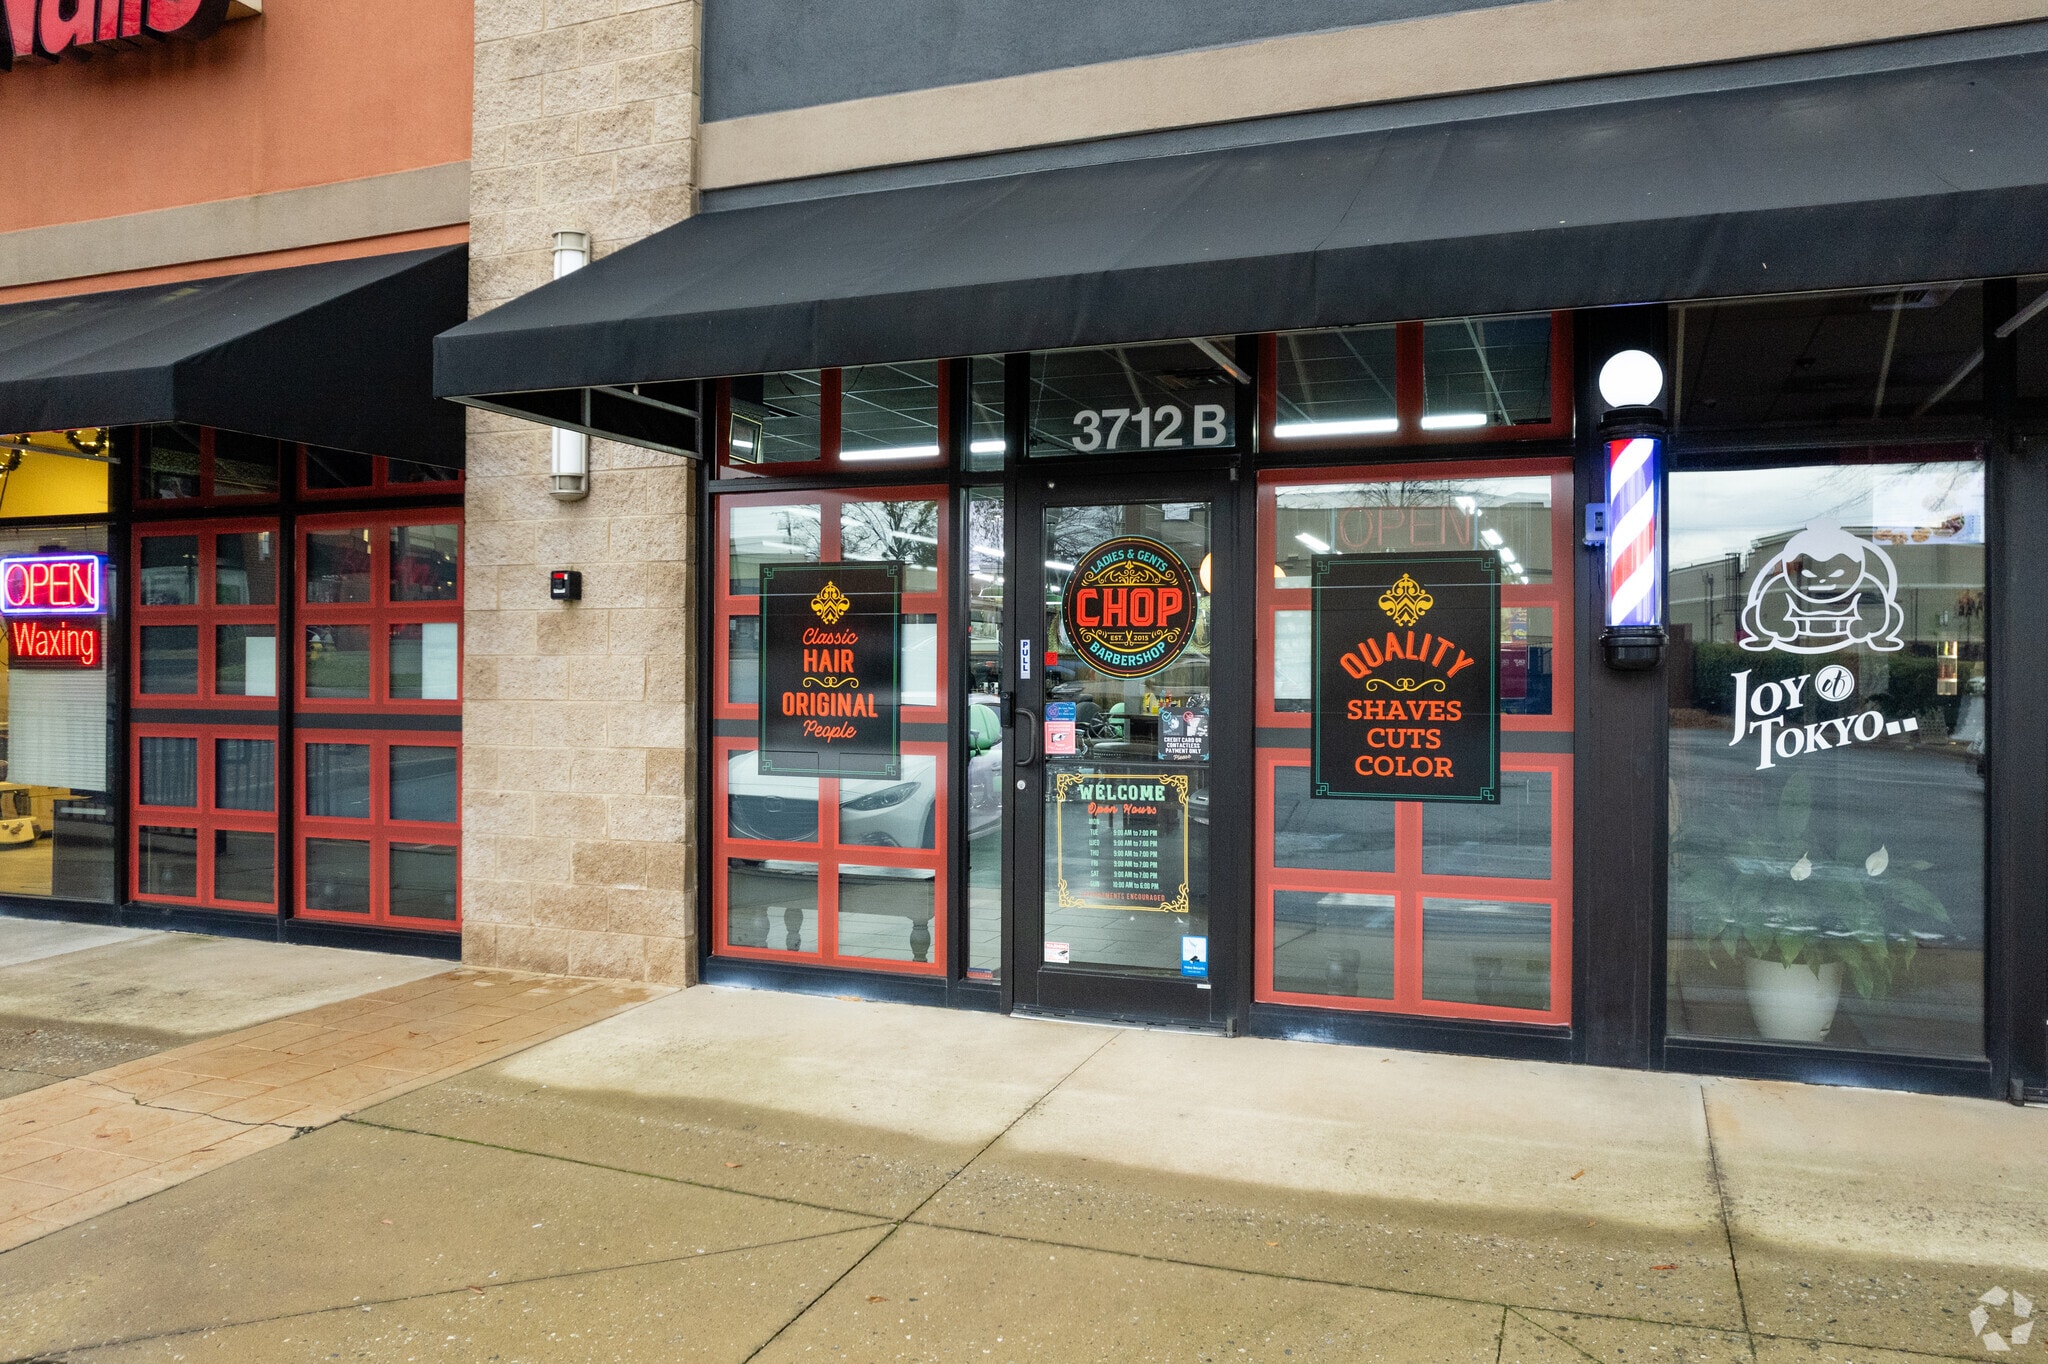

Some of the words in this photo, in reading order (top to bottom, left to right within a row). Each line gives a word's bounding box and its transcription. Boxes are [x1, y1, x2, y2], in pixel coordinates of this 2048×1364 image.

[1072, 404, 1183, 451] 3712
[1193, 404, 1226, 446] B
[1338, 505, 1472, 548] OPEN
[1090, 549, 1125, 574] LADIES
[1127, 549, 1135, 559] &
[1137, 550, 1168, 572] GENTS
[4, 562, 96, 607] OPEN
[1076, 587, 1183, 627] CHOP
[12, 621, 95, 665] Waxing
[802, 627, 858, 645] Classic
[803, 649, 855, 673] HAIR
[1089, 641, 1167, 667] BARBERSHOP
[1340, 630, 1475, 679] QUALITY
[782, 691, 878, 718] ORIGINAL
[1347, 699, 1462, 721] SHAVES
[1728, 669, 1811, 747] JOY
[803, 719, 857, 743] People
[1366, 728, 1441, 749] CUTS
[1354, 755, 1453, 777] COLOR
[1079, 784, 1166, 801] WELCOME
[1087, 801, 1118, 816] Open
[1122, 803, 1157, 815] Hours
